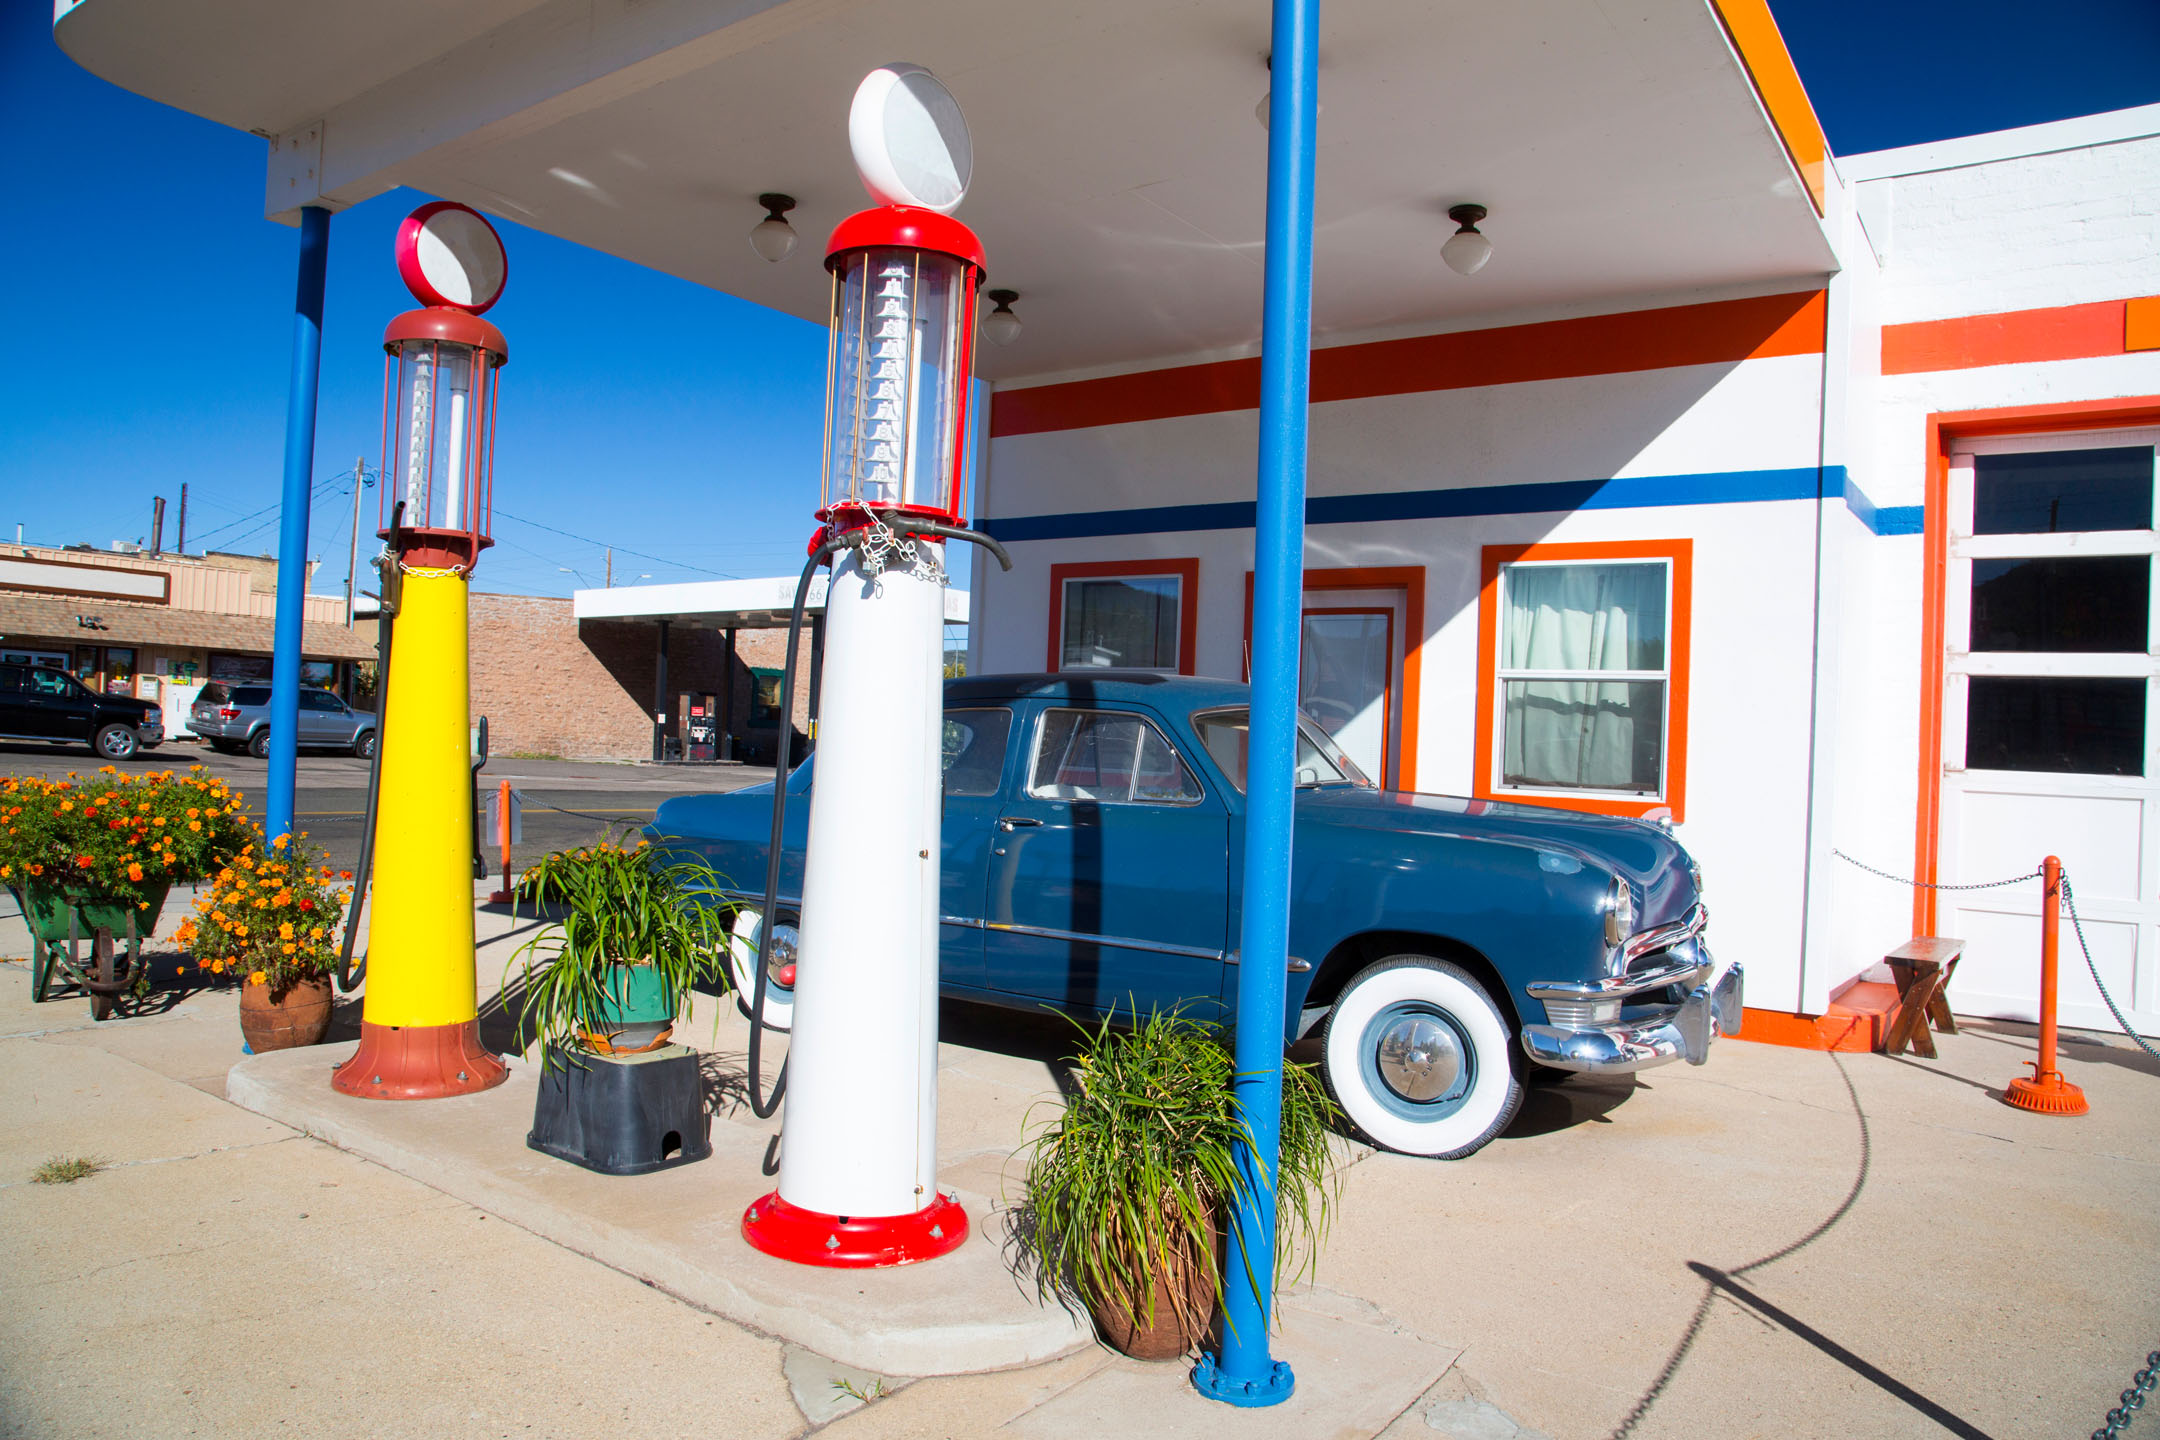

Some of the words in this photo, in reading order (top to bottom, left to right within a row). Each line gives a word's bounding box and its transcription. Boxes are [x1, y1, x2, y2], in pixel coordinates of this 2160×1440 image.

[887, 303, 896, 314] 2
[885, 323, 895, 336] 3
[883, 343, 893, 356] 4
[883, 364, 893, 376] 5
[880, 406, 890, 418] 7
[879, 427, 888, 439] 8
[877, 447, 886, 459] 9
[875, 468, 887, 480] 10
[809, 588, 822, 600] 66
